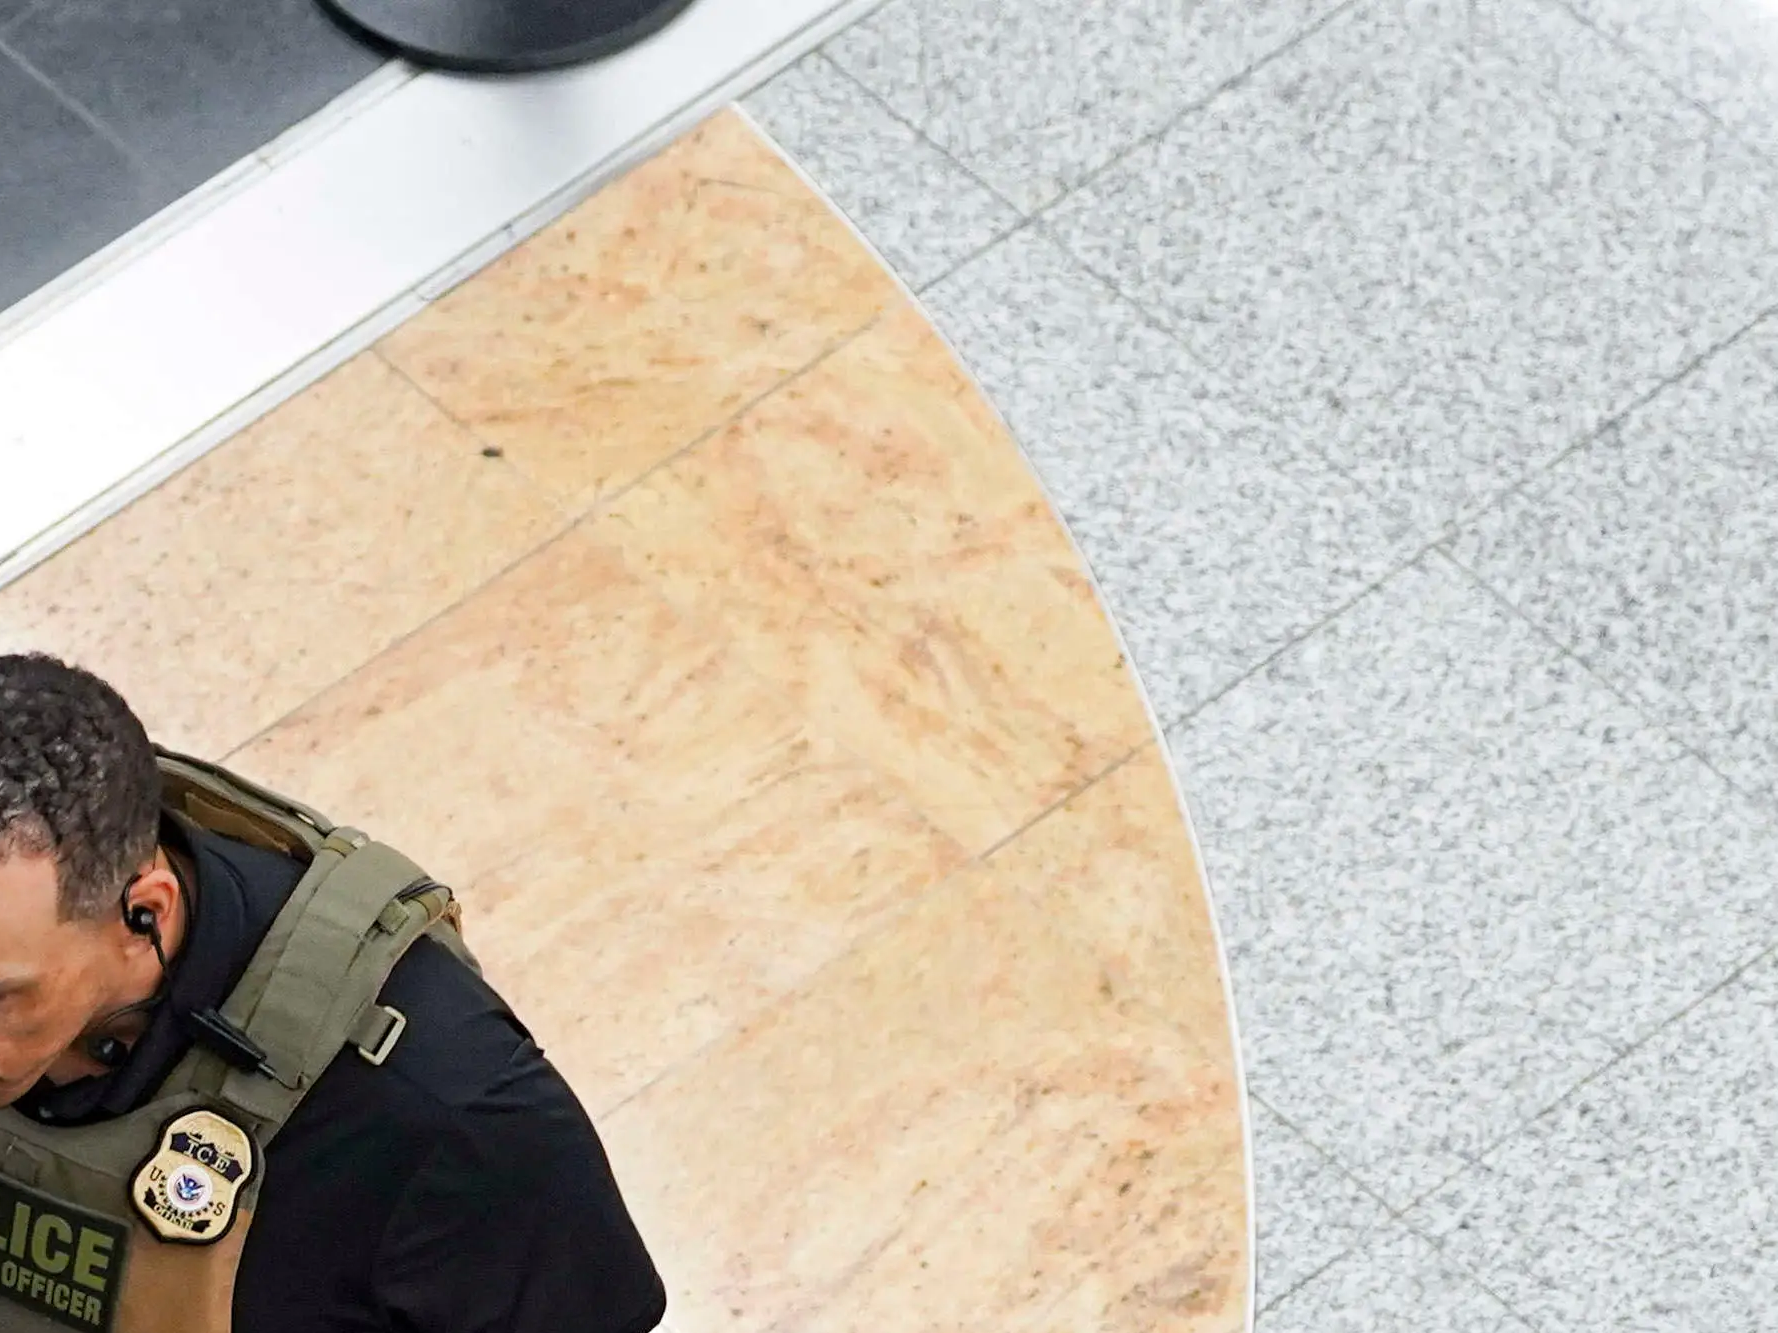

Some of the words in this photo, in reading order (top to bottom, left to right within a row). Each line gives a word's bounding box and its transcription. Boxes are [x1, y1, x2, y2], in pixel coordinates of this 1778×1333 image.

[184, 1139, 231, 1174] ICE
[149, 1166, 164, 1181] U
[213, 1202, 226, 1217] S
[0, 1259, 103, 1326] OFFICER
